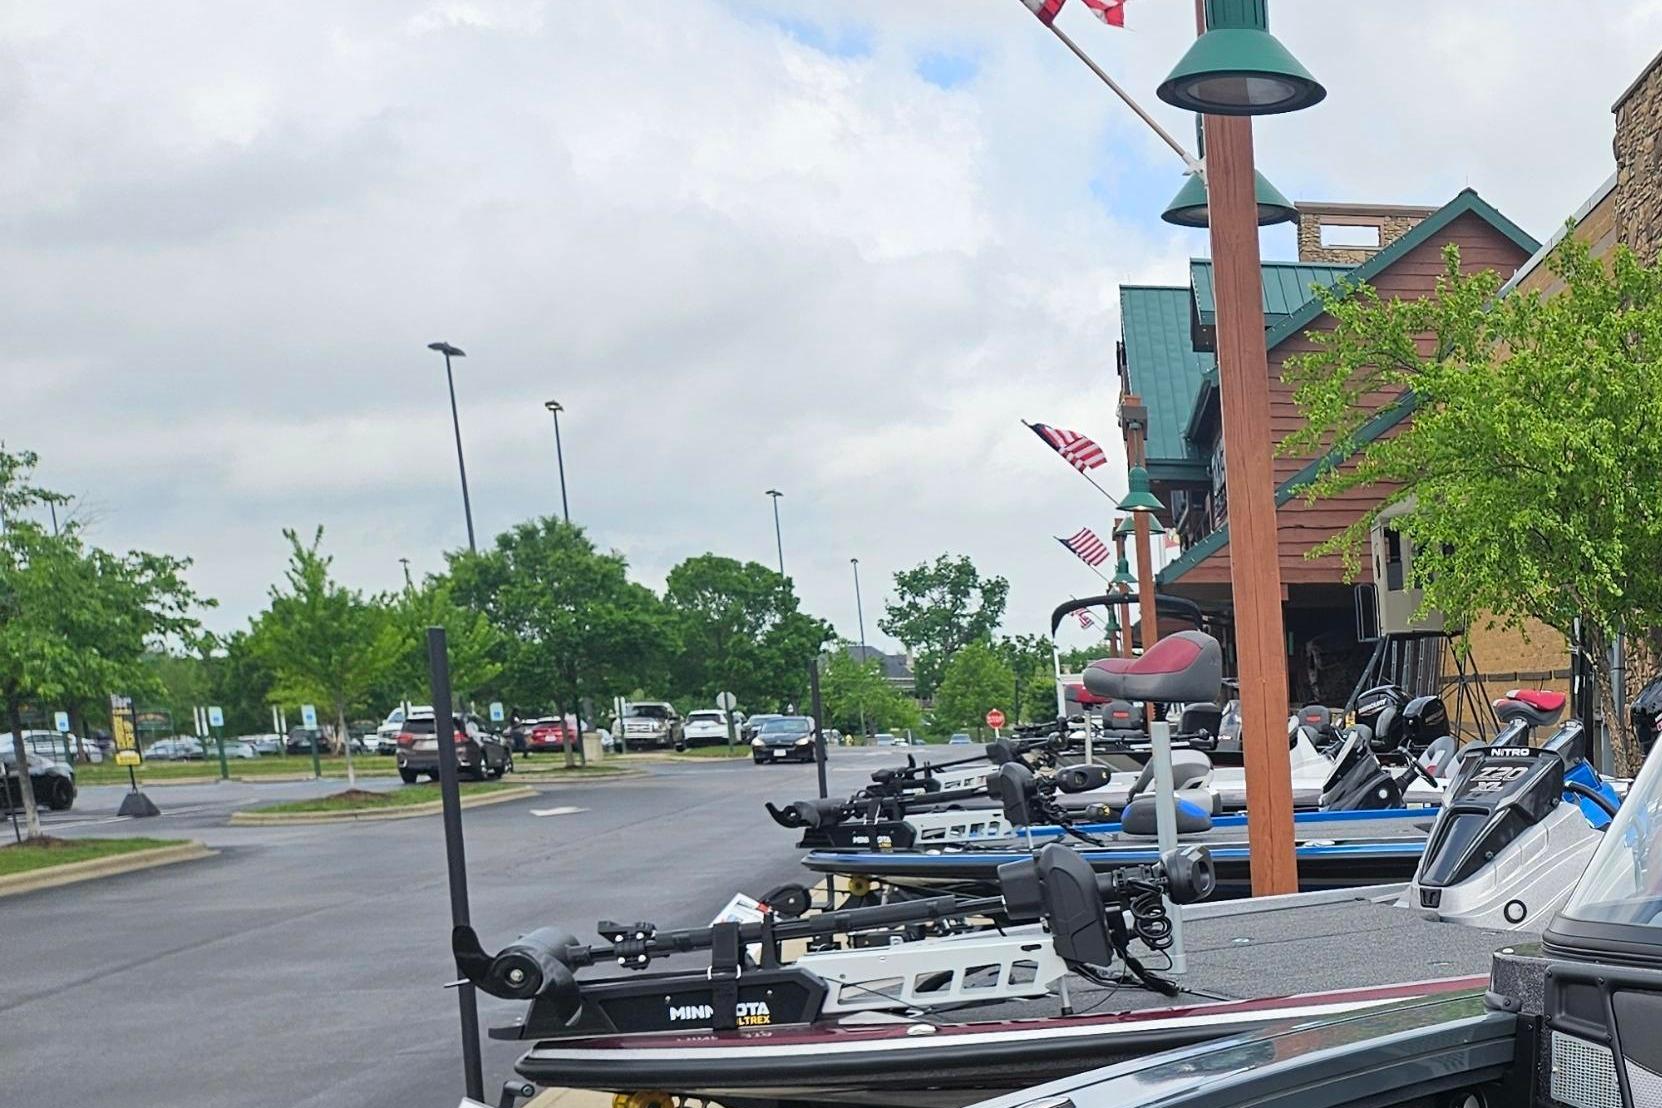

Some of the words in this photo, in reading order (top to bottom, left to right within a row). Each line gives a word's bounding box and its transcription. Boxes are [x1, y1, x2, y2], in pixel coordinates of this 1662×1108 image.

[1491, 748, 1530, 756] NITRO
[1470, 766, 1529, 781] Z20
[736, 1001, 770, 1016] OTA
[736, 1015, 771, 1026] LTREX
